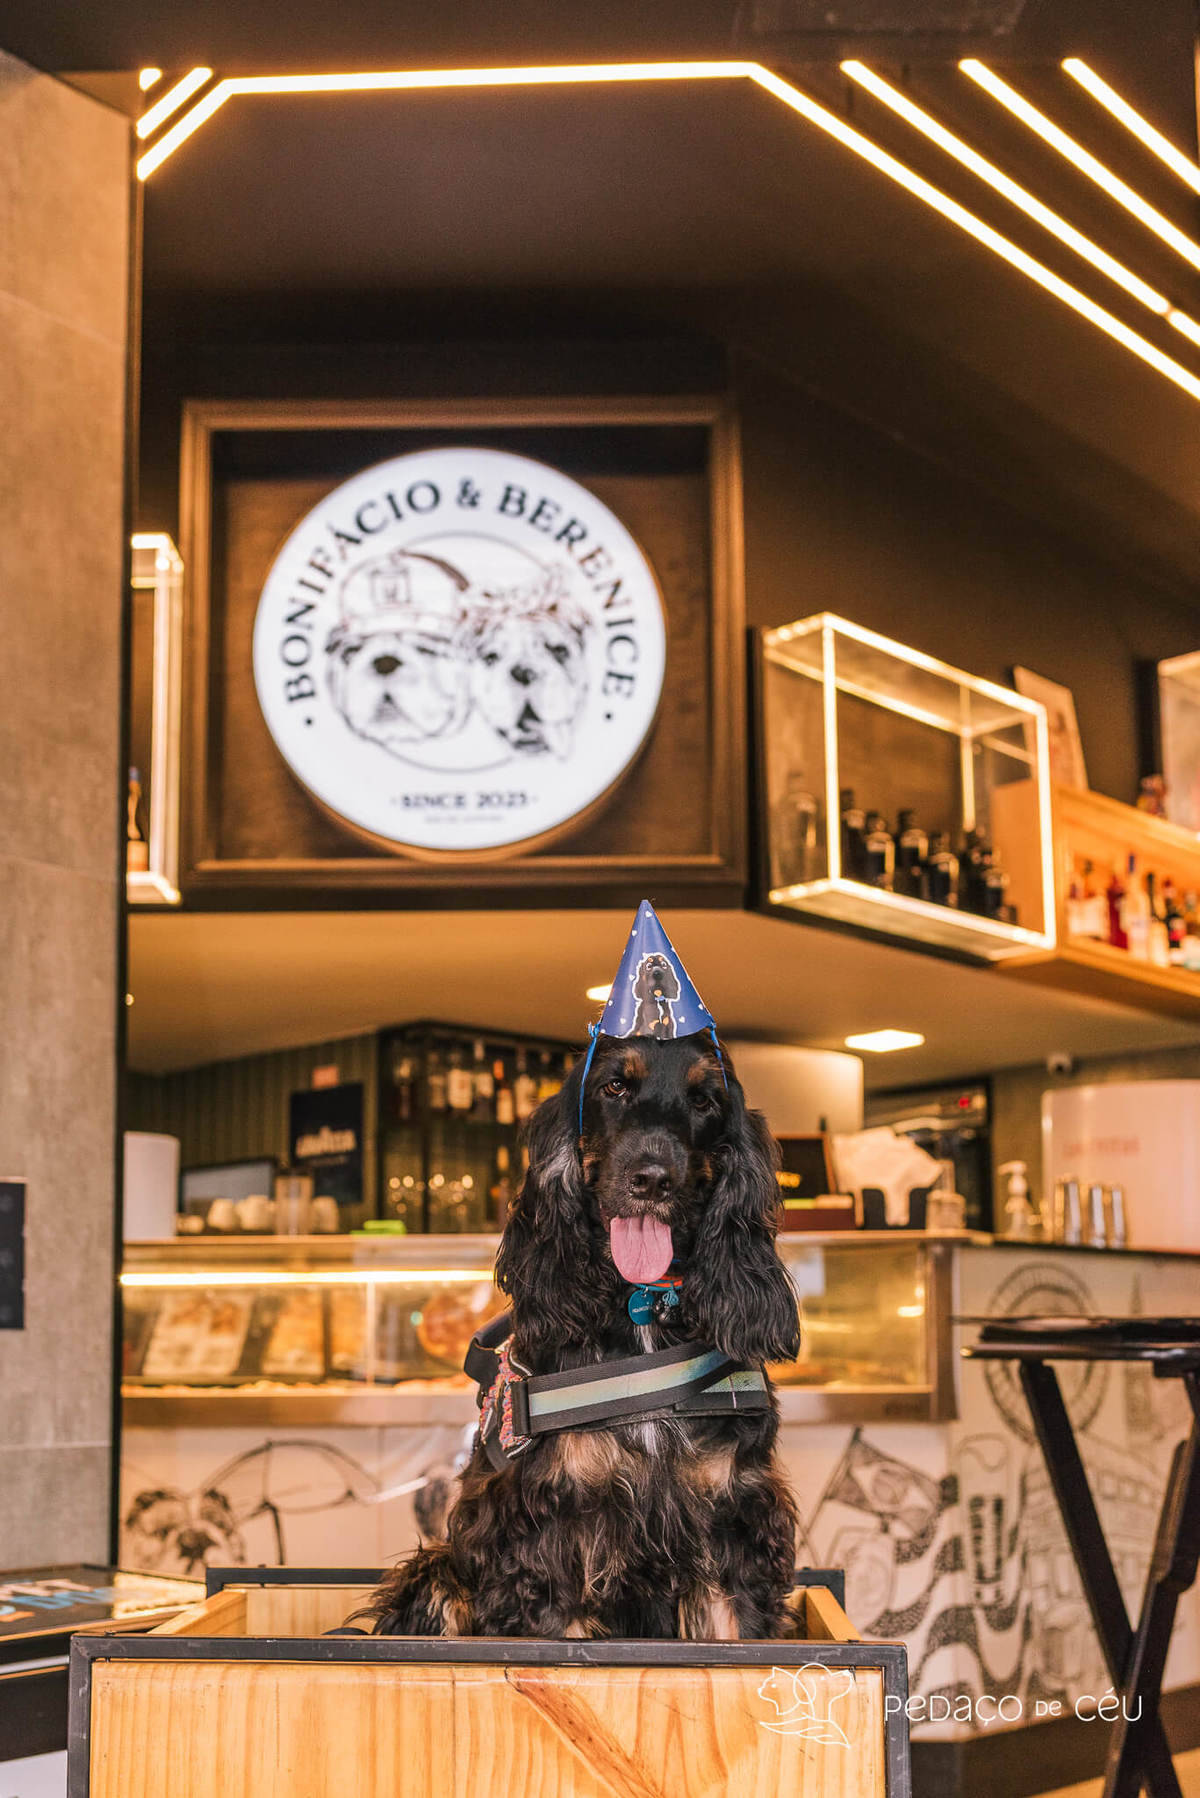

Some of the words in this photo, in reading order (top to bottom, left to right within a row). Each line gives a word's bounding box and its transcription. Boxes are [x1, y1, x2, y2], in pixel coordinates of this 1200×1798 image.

[280, 479, 441, 703] BONIFÁCIO
[456, 478, 482, 509] &
[498, 483, 640, 698] BERENICE
[401, 792, 467, 810] SINCE
